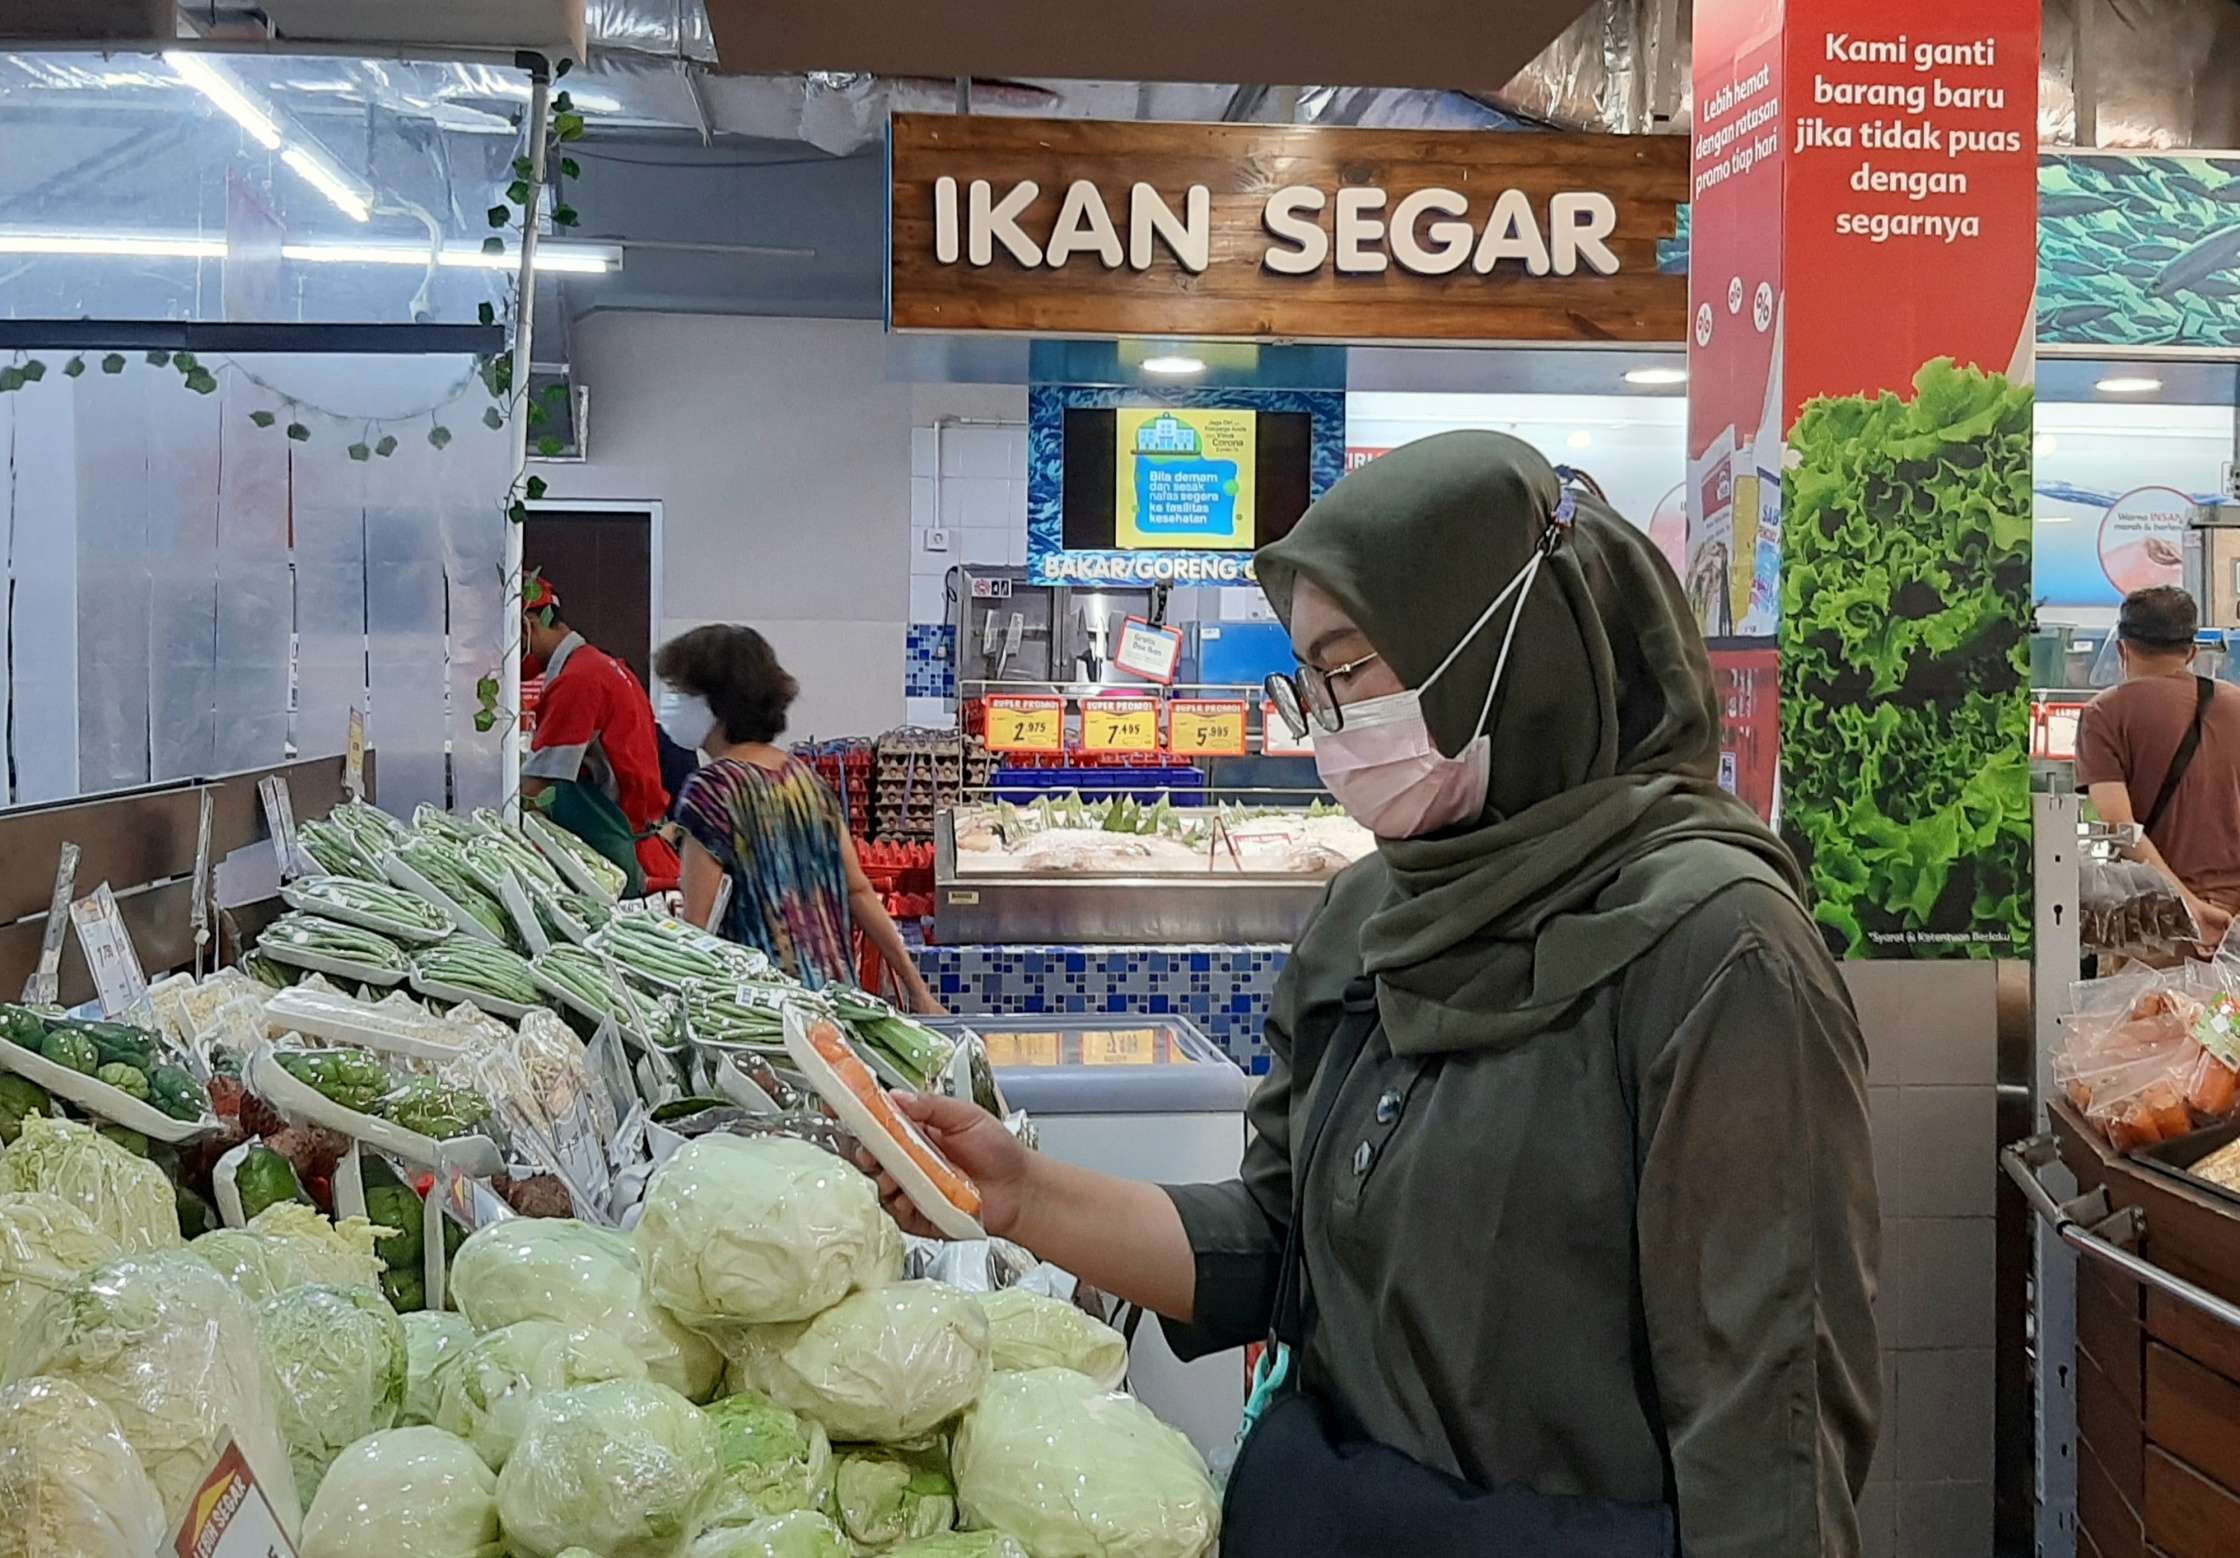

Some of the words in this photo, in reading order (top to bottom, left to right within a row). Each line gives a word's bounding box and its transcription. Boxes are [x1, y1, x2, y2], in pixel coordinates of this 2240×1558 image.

[1825, 32, 1907, 63] Kami
[1914, 38, 1995, 71] ganti
[1703, 83, 1733, 123] Lebih
[1733, 62, 1769, 104] hemat
[1814, 74, 1926, 114] barang
[1933, 78, 2004, 108] baru
[1695, 123, 1735, 160] dengan
[1735, 97, 1778, 138] ratasan
[1793, 117, 1852, 153] jika
[1859, 120, 1942, 149] tidak
[1949, 129, 2021, 157] puas
[1695, 159, 1730, 200] promo
[1731, 146, 1753, 174] tiap
[1754, 125, 1778, 163] hari
[1850, 162, 1967, 200] dengan
[934, 176, 1211, 273] IKAN
[1263, 185, 1620, 277] SEGAR
[1836, 212, 1979, 243] segarnya
[1212, 438, 1244, 447] Corona
[1149, 470, 1172, 482] Bila
[1174, 470, 1218, 482] demam
[1149, 481, 1170, 492] dan
[1180, 491, 1219, 504] segera
[1149, 502, 1164, 513] ke
[1165, 501, 1209, 513] fasilitas
[1149, 512, 1207, 525] kesehatan
[2118, 512, 2148, 521] Warna
[2144, 522, 2152, 531] &
[993, 700, 1023, 709] SUPER
[1087, 701, 1113, 711] SUPER
[1175, 703, 1202, 712] SUPER
[1906, 930, 1916, 943] &
[1917, 931, 1970, 943] Ketentuan
[1972, 931, 2010, 942] Berlaku
[212, 1473, 248, 1530] SEGAR
